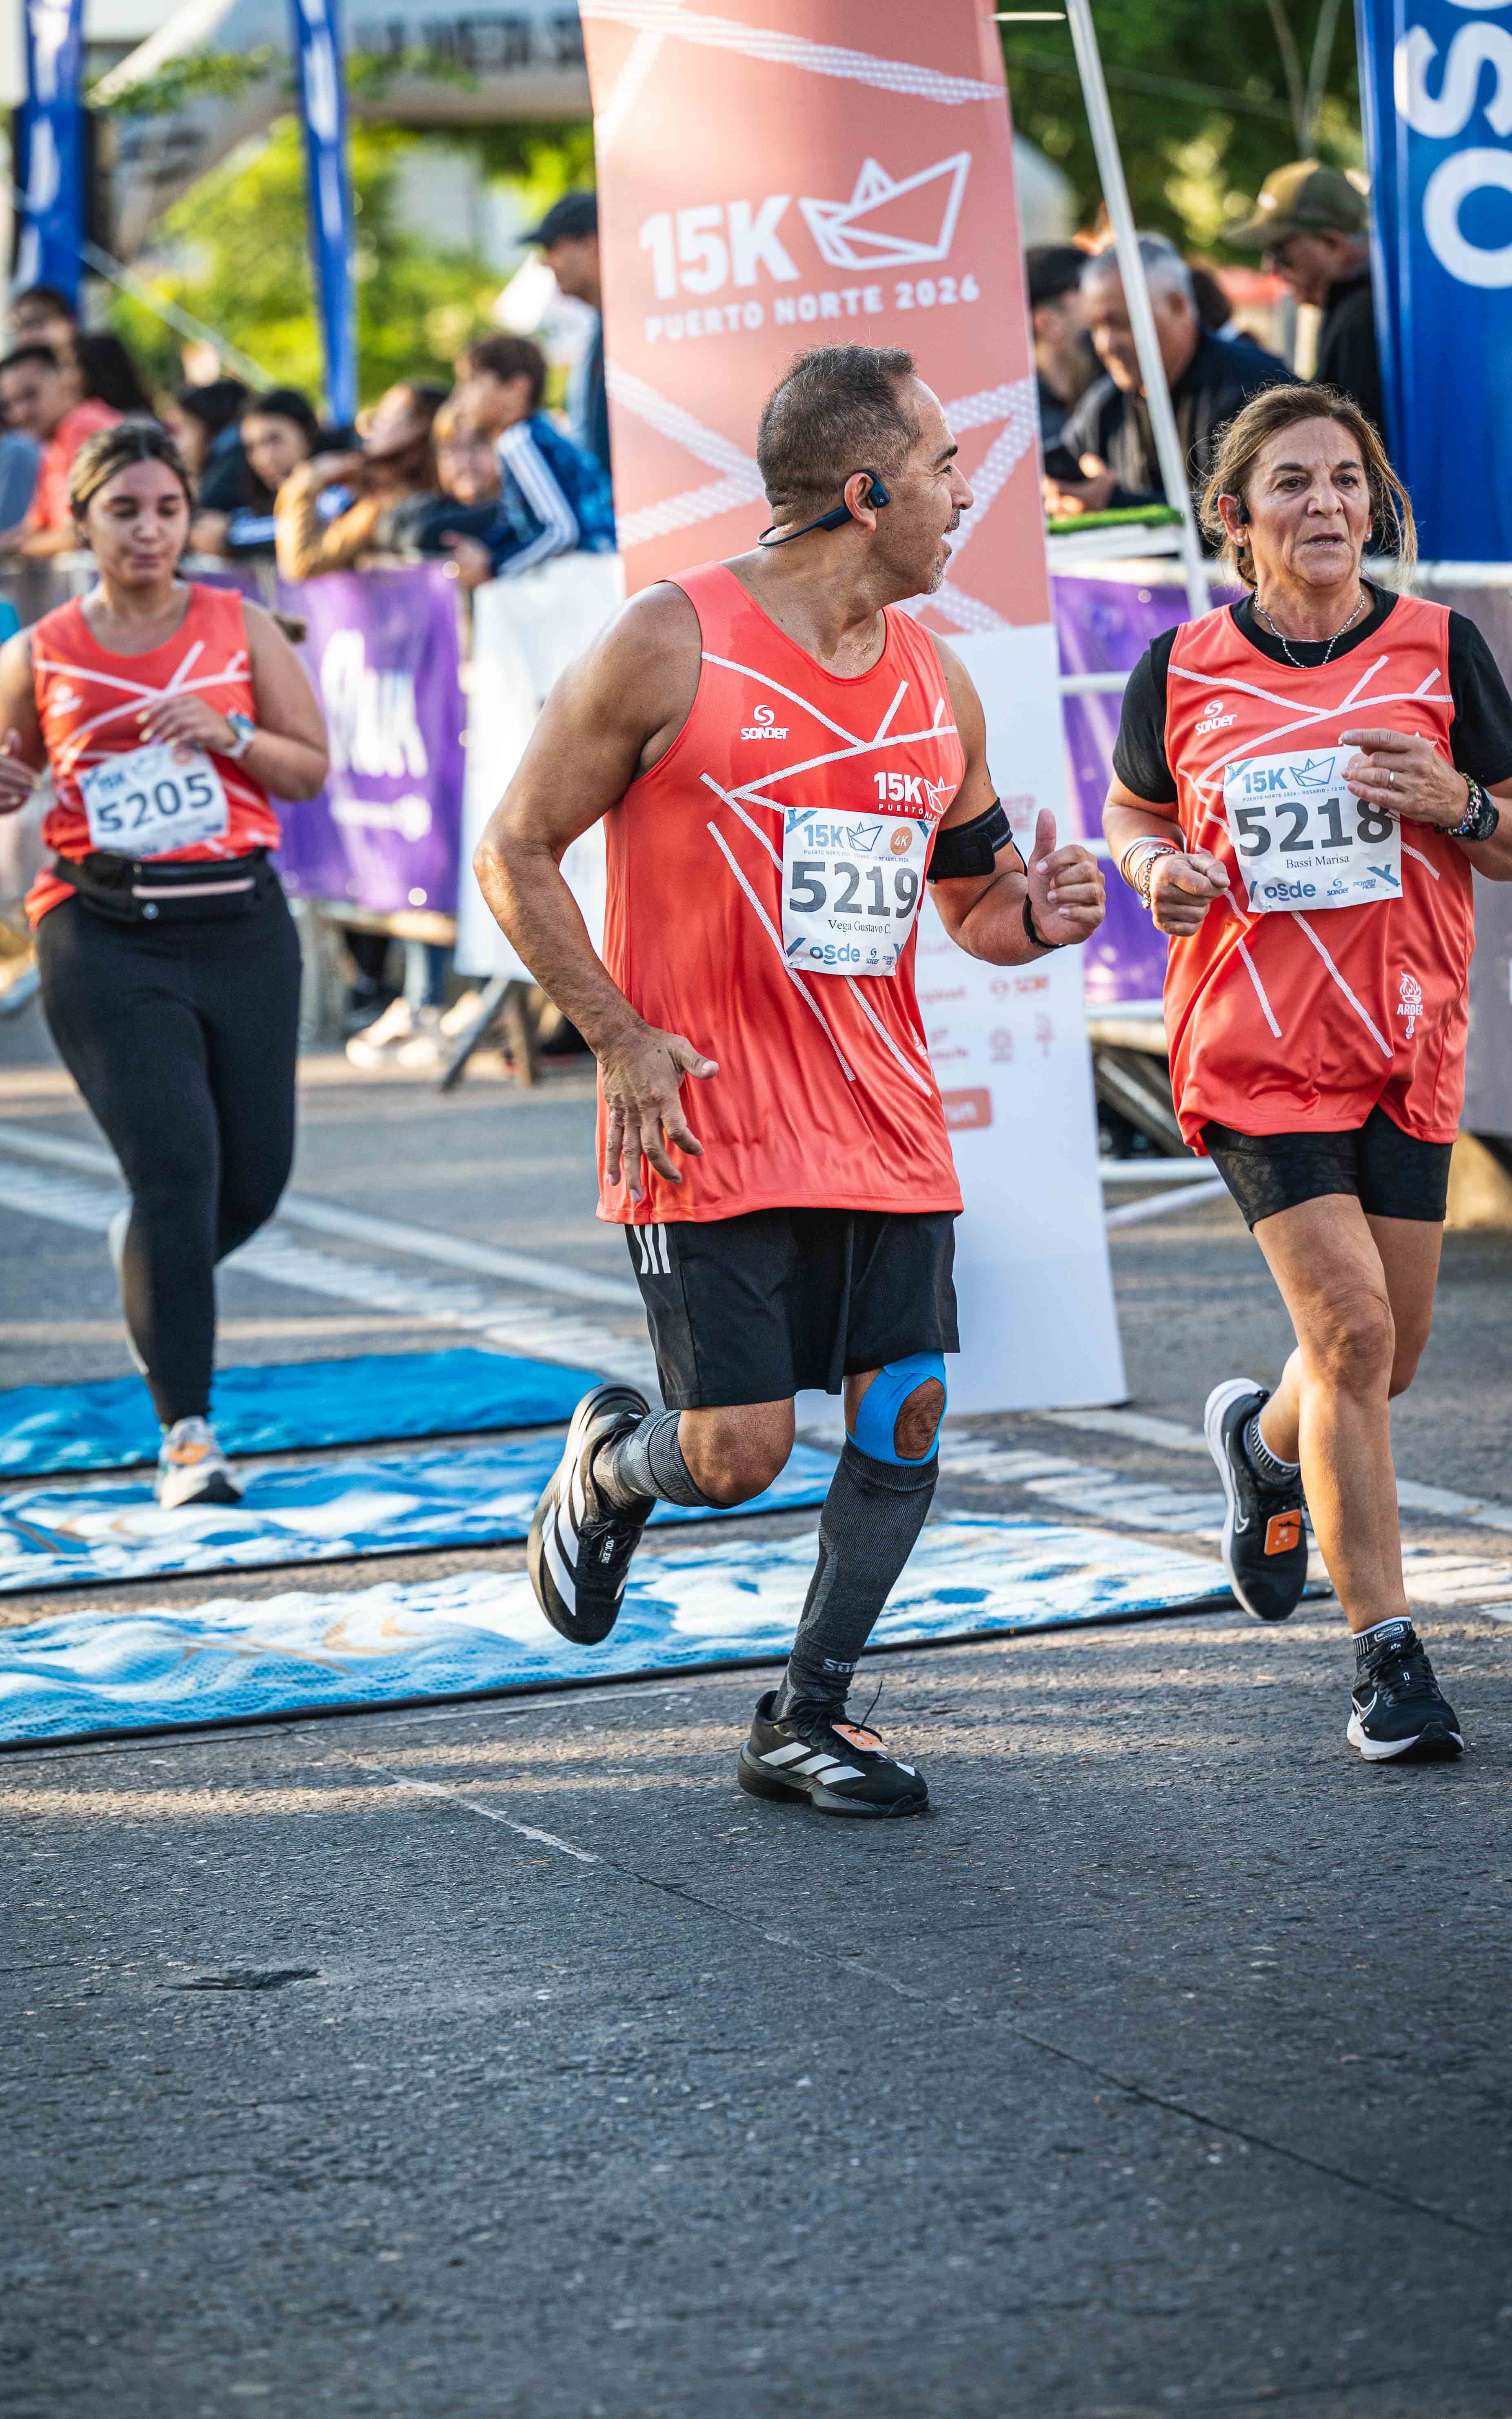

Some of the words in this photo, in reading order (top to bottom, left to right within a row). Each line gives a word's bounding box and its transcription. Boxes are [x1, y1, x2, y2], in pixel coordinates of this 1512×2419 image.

[639, 193, 801, 300] 15K
[644, 300, 764, 344] PUERTO
[773, 286, 883, 326] NORTE
[895, 274, 980, 310] 2026
[873, 771, 923, 804] 15K
[1242, 767, 1288, 794] 15K
[97, 773, 213, 832] 5205
[879, 804, 924, 815] PUERTO
[804, 824, 844, 848] 15K
[894, 835, 909, 846] 4K
[1234, 797, 1394, 857] 5218
[1286, 856, 1312, 869] Bassi
[1315, 853, 1350, 866] Marisa
[789, 861, 918, 919] 5219
[828, 920, 852, 933] Vega
[854, 921, 883, 934] Gustavo
[884, 924, 891, 934] C.
[1397, 1003, 1423, 1016] ARDEC
